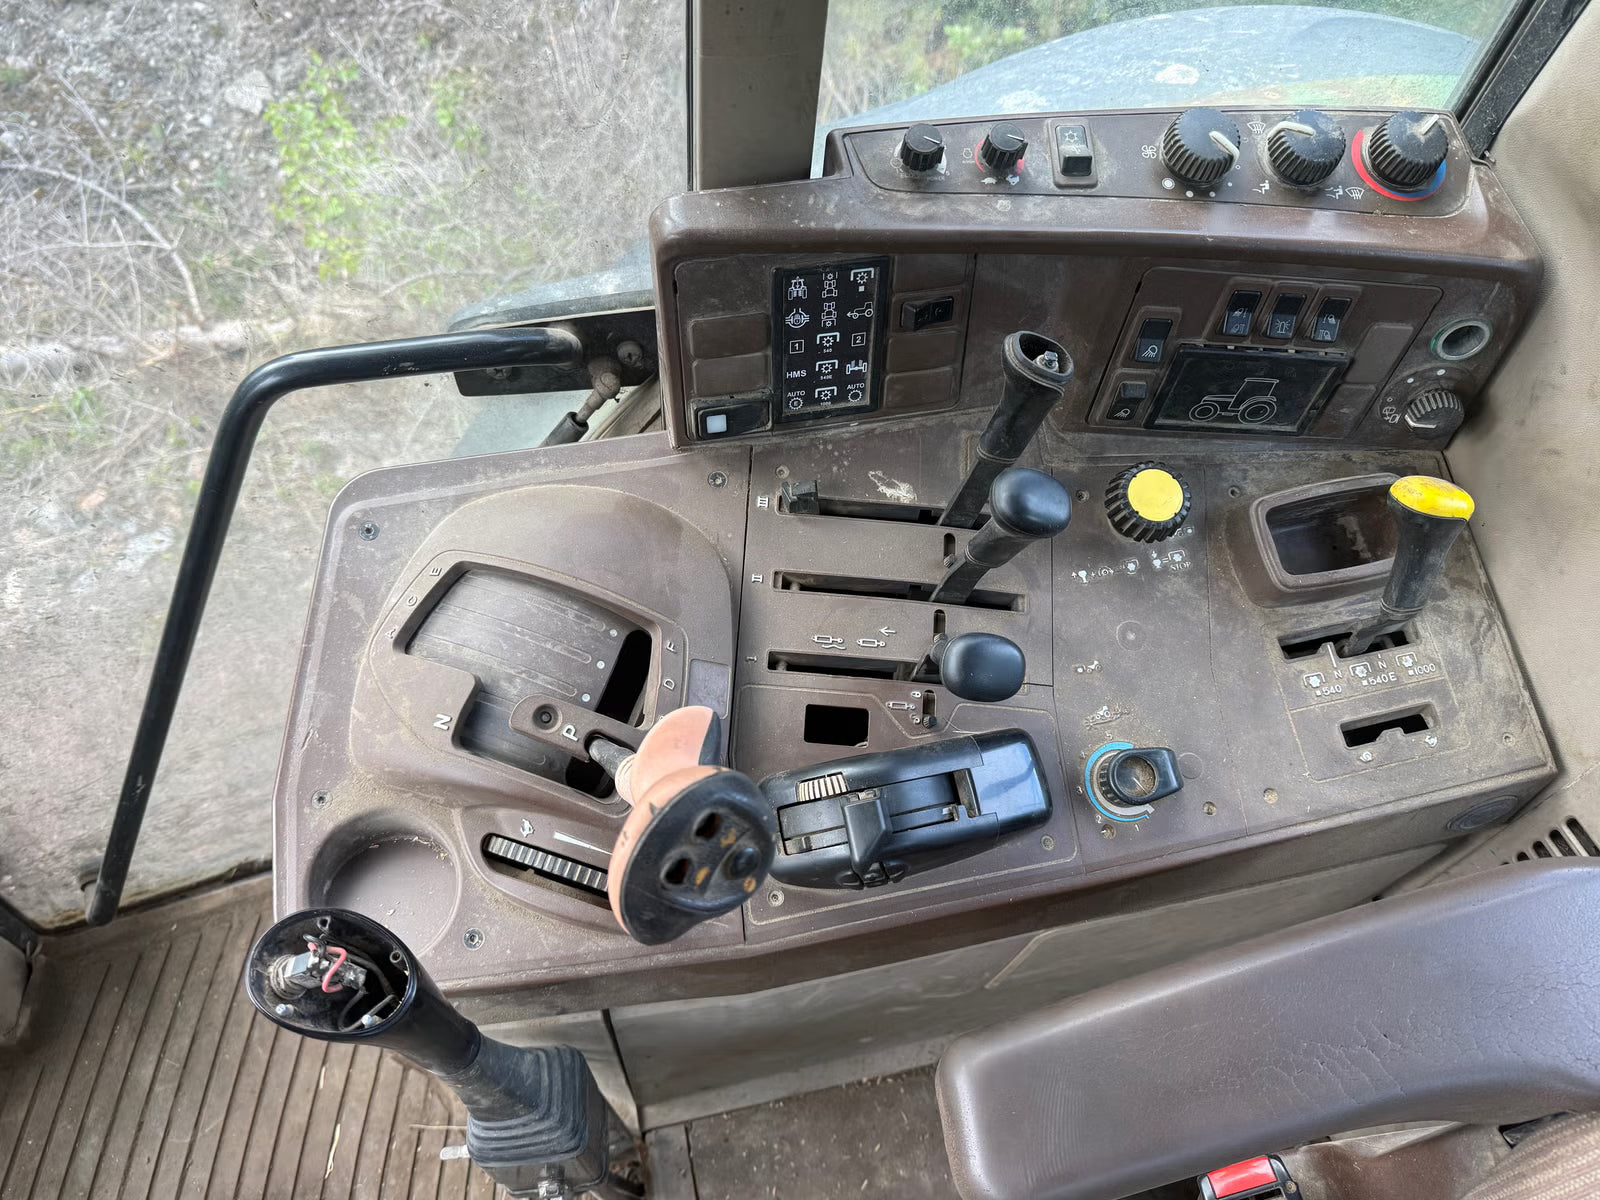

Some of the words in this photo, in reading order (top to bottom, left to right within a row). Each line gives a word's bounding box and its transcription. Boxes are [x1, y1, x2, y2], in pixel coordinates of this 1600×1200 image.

[856, 336, 862, 344] 2
[794, 343, 799, 351] 1
[786, 369, 807, 379] HMS
[787, 390, 806, 398] AUTO
[1170, 561, 1191, 571] STOP
[430, 567, 442, 577] E
[407, 595, 418, 607] C
[384, 627, 397, 640] A
[666, 640, 677, 654] F
[1378, 660, 1387, 669] N
[1414, 663, 1436, 675] 1000
[1334, 670, 1343, 679] N
[663, 679, 675, 690] D
[1369, 674, 1388, 686] 540
[1322, 685, 1342, 696] 540
[433, 713, 452, 731] N
[561, 724, 579, 742] P
[1095, 815, 1102, 824] 2
